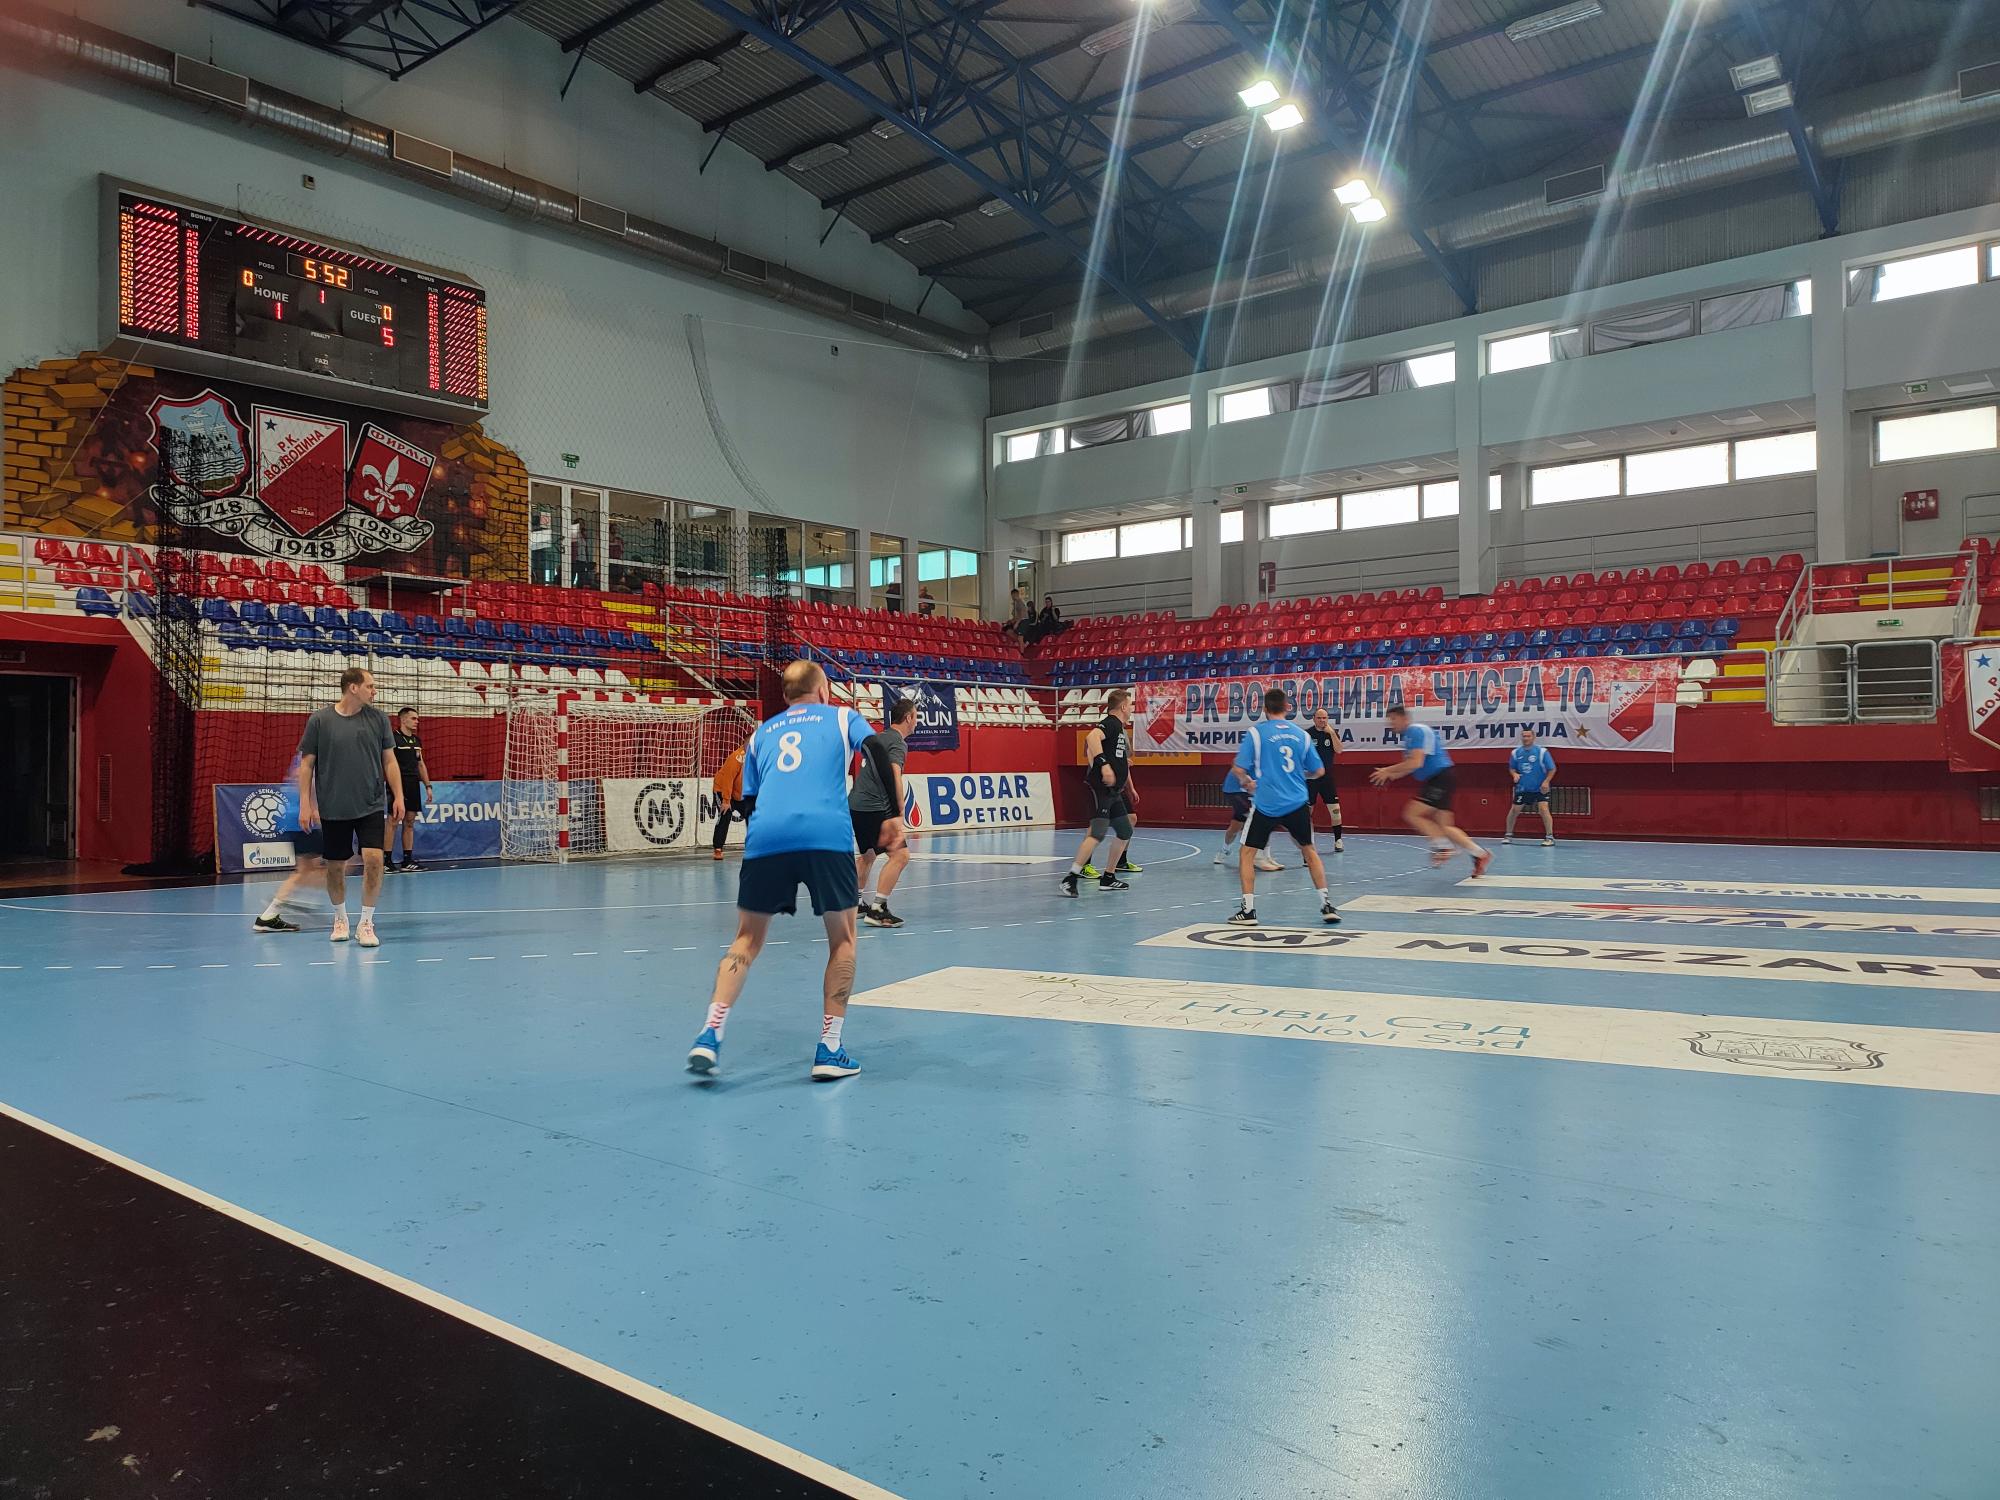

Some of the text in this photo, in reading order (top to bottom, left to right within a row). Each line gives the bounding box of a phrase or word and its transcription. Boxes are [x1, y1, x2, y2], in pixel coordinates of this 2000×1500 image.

[190, 212, 212, 222] BONUS
[258, 261, 275, 270] POSS
[304, 259, 348, 288] 5:52
[242, 270, 254, 287] 0
[254, 287, 289, 303] HOME
[320, 290, 325, 304] 1
[275, 302, 282, 320] 1
[350, 309, 382, 326] GUEST
[383, 305, 392, 321] 0
[382, 327, 394, 346] 5
[263, 429, 325, 480] ВОЈВОДИНА
[370, 429, 429, 465] ФИРМА
[360, 519, 403, 543] 1989
[273, 538, 336, 558] 1948
[1185, 683, 1219, 722] РК
[1432, 666, 1545, 716] ЧИСТА
[1556, 666, 1594, 714] 10
[1475, 721, 1568, 739] ТИТУЛА
[777, 731, 802, 773] 8
[1279, 745, 1295, 773] 3
[927, 775, 1030, 825] BOBAR
[963, 806, 1033, 823] PETROL
[261, 856, 291, 865] GAZPROM
[1693, 887, 1924, 900] GAZPROM
[1394, 939, 2000, 980] MOZZART
[1179, 1001, 1358, 1023] Нови
[1386, 1016, 1531, 1039] Сад
[1283, 1023, 1400, 1040] Novi
[1417, 1033, 1525, 1050] Sad
